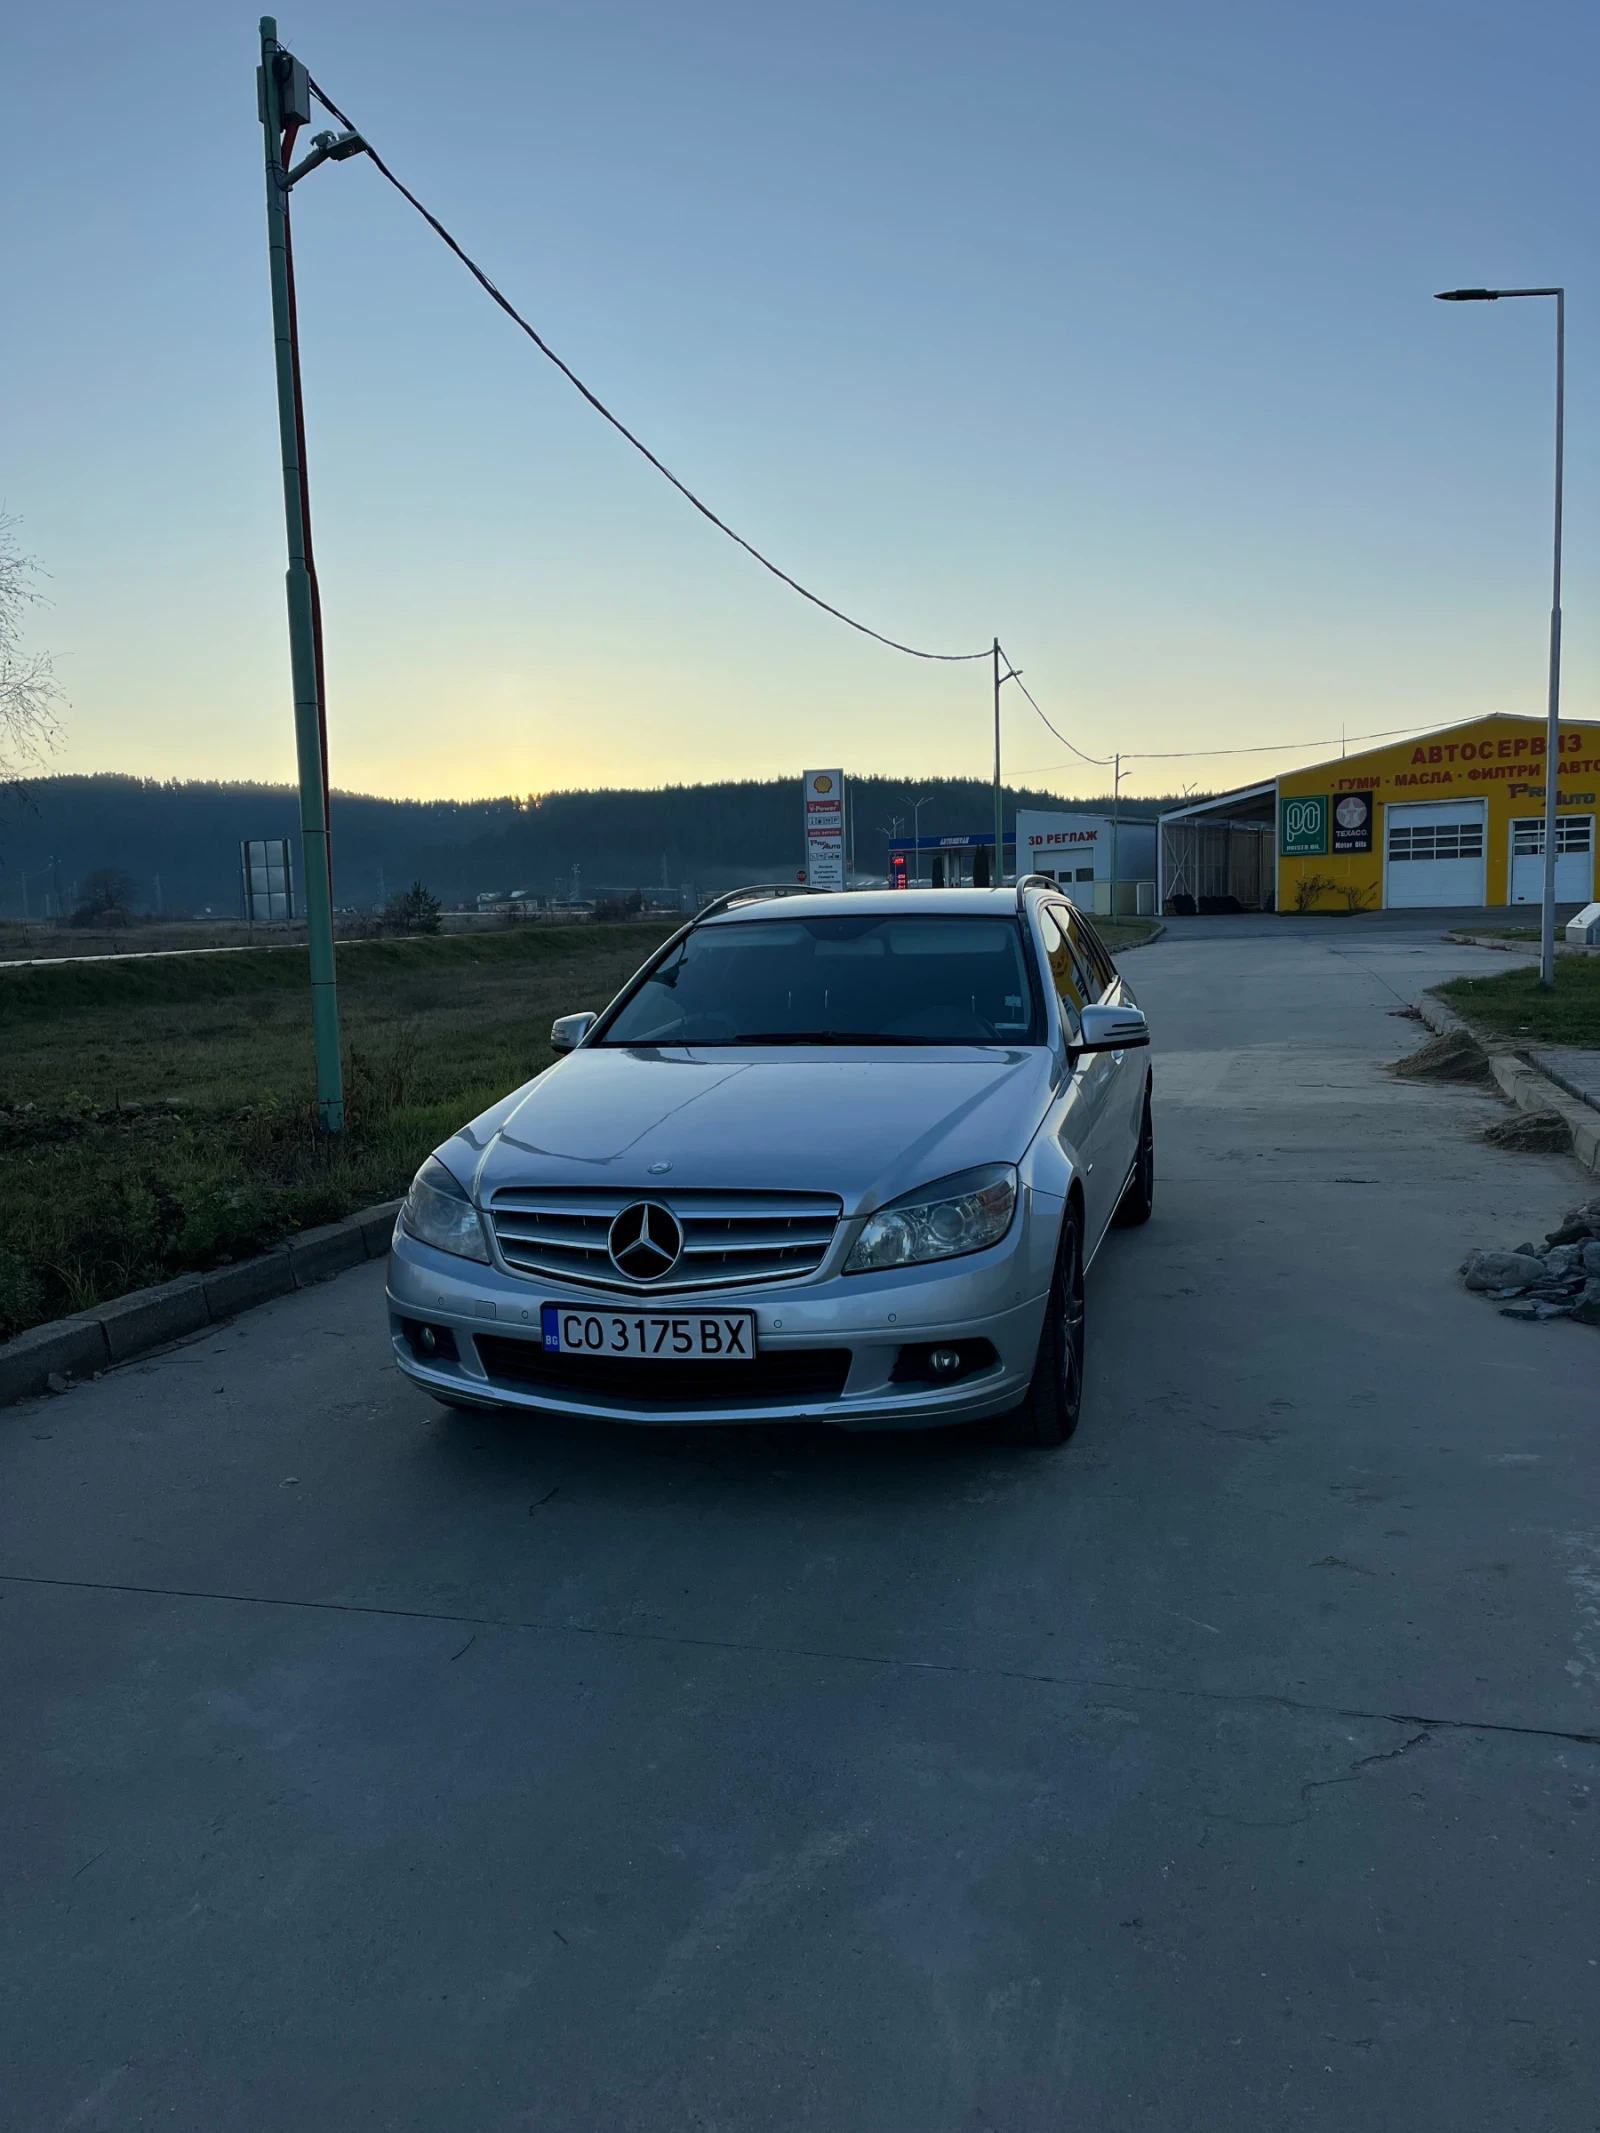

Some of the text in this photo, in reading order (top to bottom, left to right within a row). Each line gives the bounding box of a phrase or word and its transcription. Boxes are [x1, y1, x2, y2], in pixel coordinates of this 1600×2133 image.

[1338, 776, 1381, 790] ГУМИ
[1395, 771, 1453, 786] МАСЛА
[1467, 764, 1541, 781] ФИЛТРИ
[1507, 783, 1547, 799] PR
[809, 804, 837, 812] V-Power
[1028, 830, 1098, 846] 3D РЕГЛАЖ
[1336, 829, 1367, 837] TEXACO
[545, 1335, 559, 1346] BG
[563, 1315, 747, 1354] CO 3175 BX
